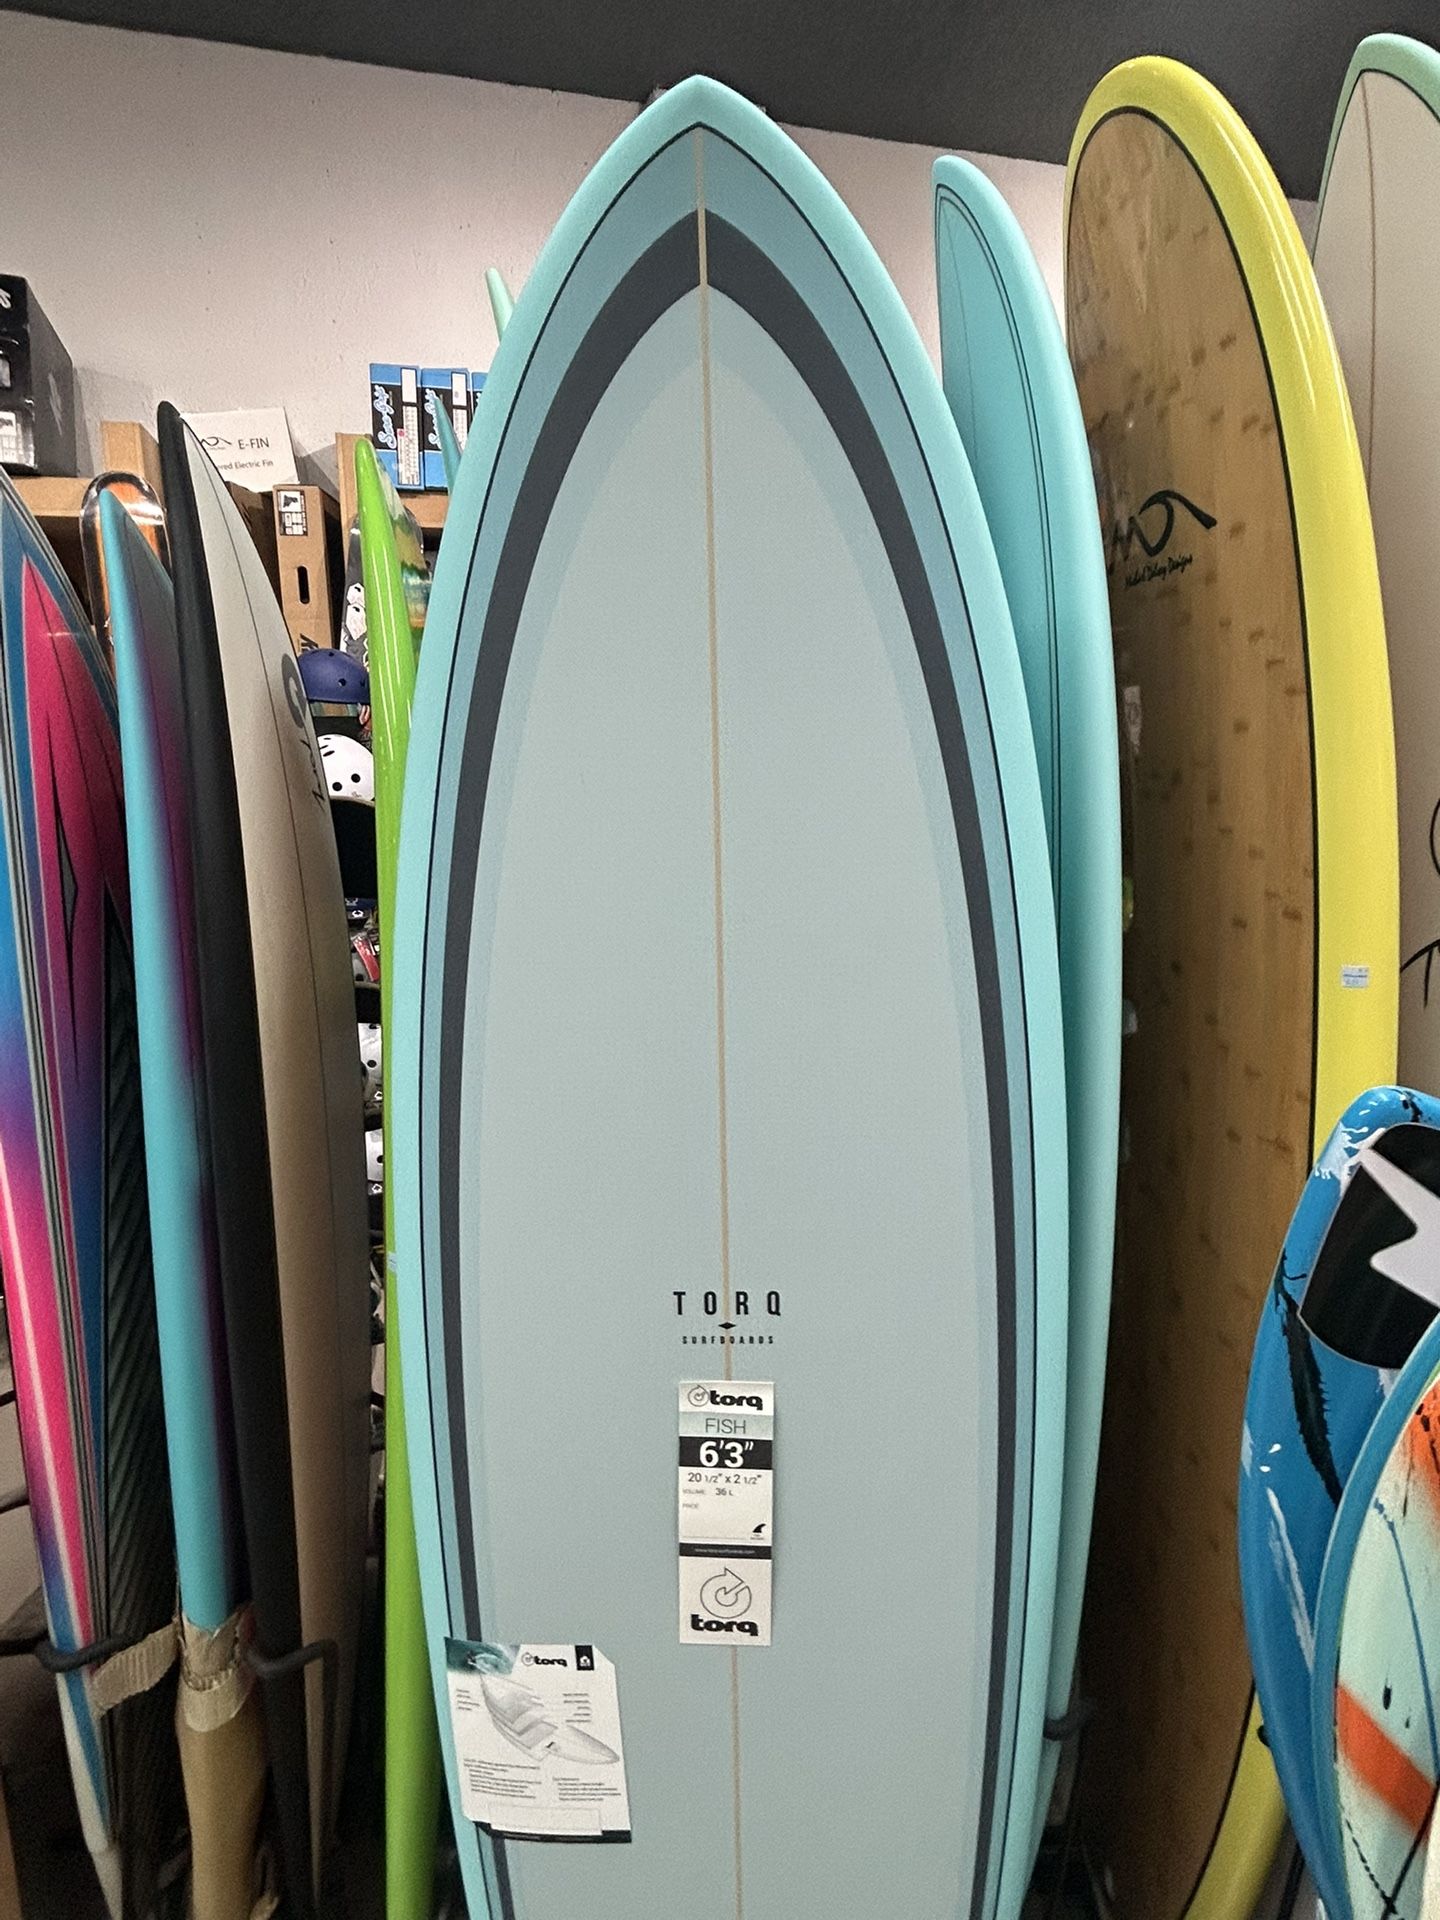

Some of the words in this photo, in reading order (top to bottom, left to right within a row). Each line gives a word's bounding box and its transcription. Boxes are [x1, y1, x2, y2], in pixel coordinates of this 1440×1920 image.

[237, 437, 270, 450] E-FIN
[234, 459, 262, 470] Electric
[673, 1291, 781, 1316] TORQ
[682, 1335, 774, 1345] SURFBOARDS
[709, 1390, 763, 1411] torq
[705, 1417, 747, 1435] FISH
[699, 1440, 754, 1468] 6'3"
[687, 1472, 702, 1483] 20
[704, 1473, 723, 1484] 1/2"
[733, 1474, 741, 1484] 2
[743, 1475, 762, 1485] 1/2"
[715, 1488, 727, 1496] 36
[690, 1614, 759, 1637] torq
[534, 1656, 568, 1667] torq
